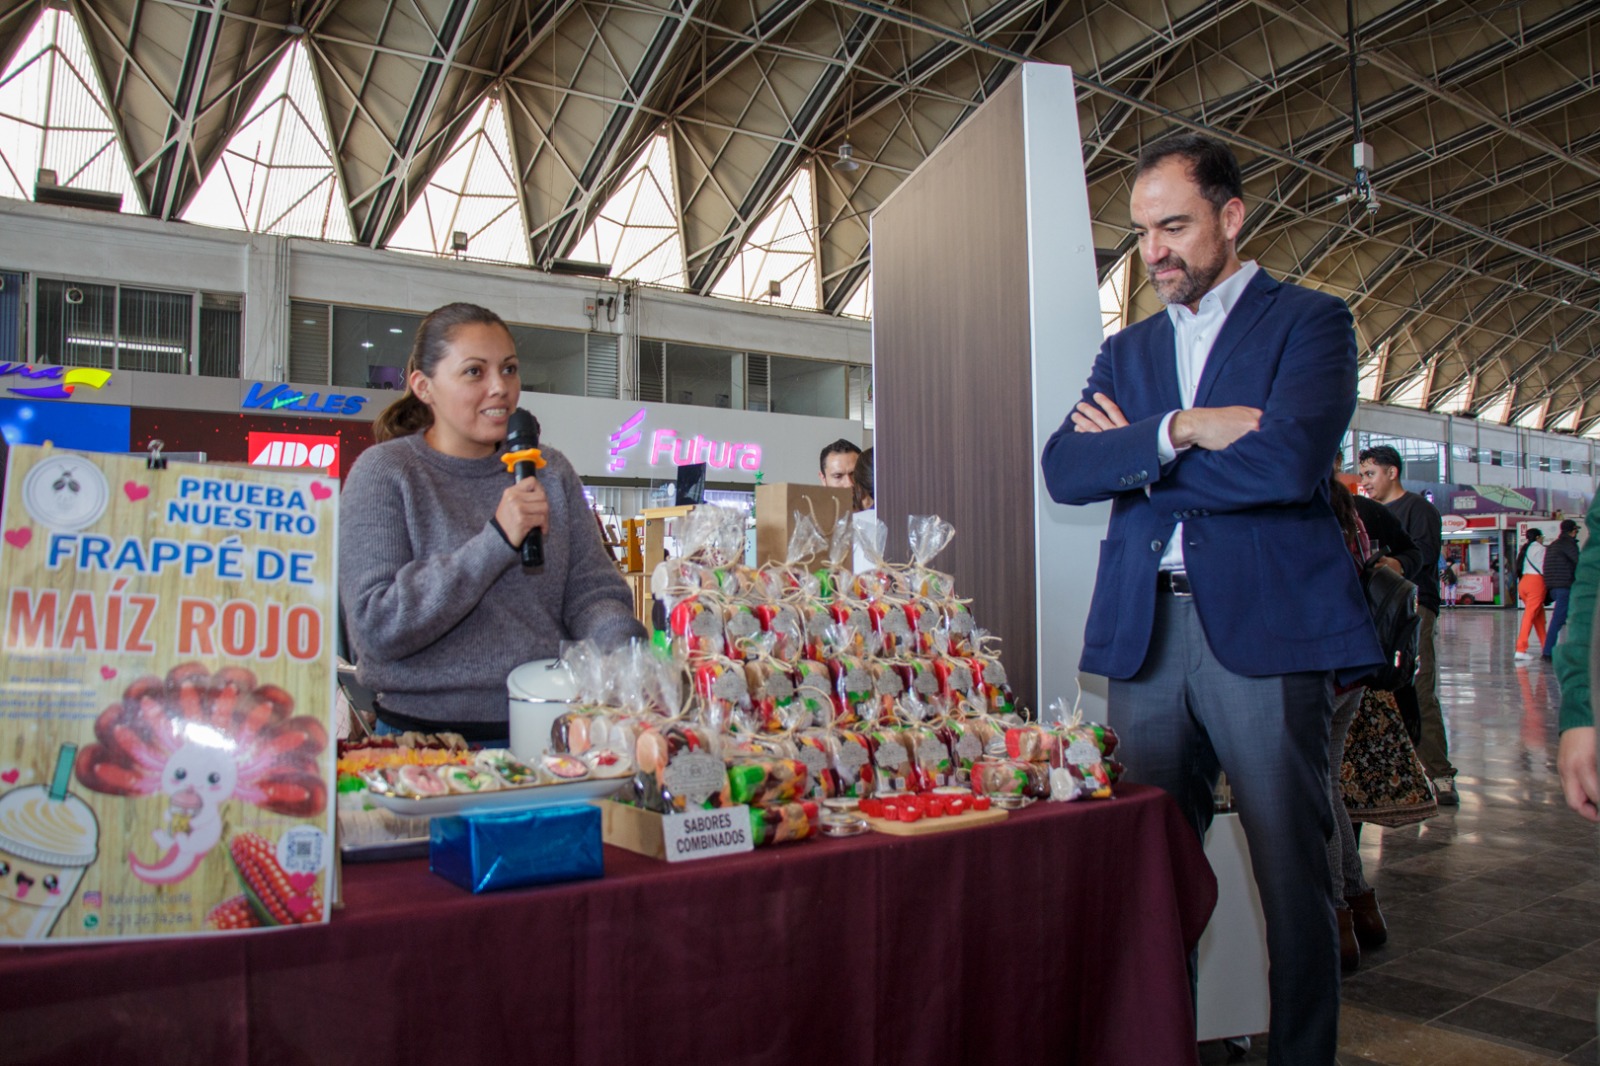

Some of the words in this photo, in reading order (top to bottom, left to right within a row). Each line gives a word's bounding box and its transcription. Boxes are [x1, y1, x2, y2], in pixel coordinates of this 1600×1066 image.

[252, 441, 336, 468] ADO
[650, 429, 762, 470] Futura
[180, 479, 306, 510] PRUEBA
[167, 502, 316, 534] NUESTRO
[48, 535, 243, 578] FRAPPÉ
[256, 550, 313, 584] DE
[6, 578, 158, 651] MAÍZ
[178, 599, 320, 659] ROJO
[684, 814, 732, 834] SABORES
[677, 830, 746, 853] COMBINADOS
